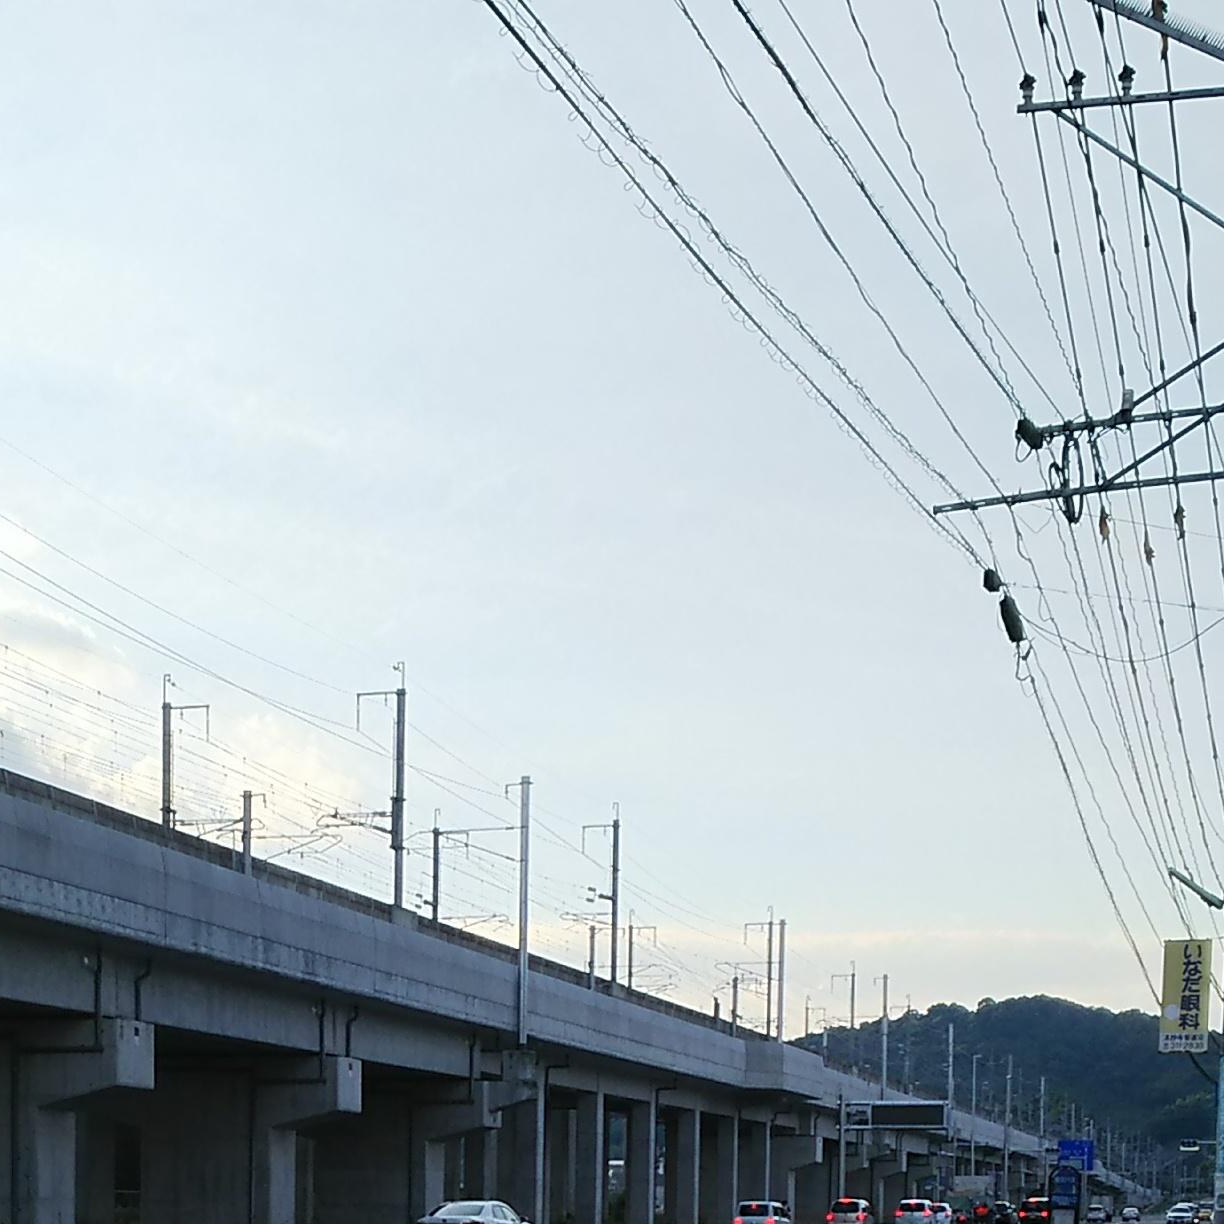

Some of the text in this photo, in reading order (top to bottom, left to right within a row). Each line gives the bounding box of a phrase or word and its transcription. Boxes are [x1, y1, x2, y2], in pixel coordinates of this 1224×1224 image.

[1178, 943, 1202, 1030] いなだ眼科
